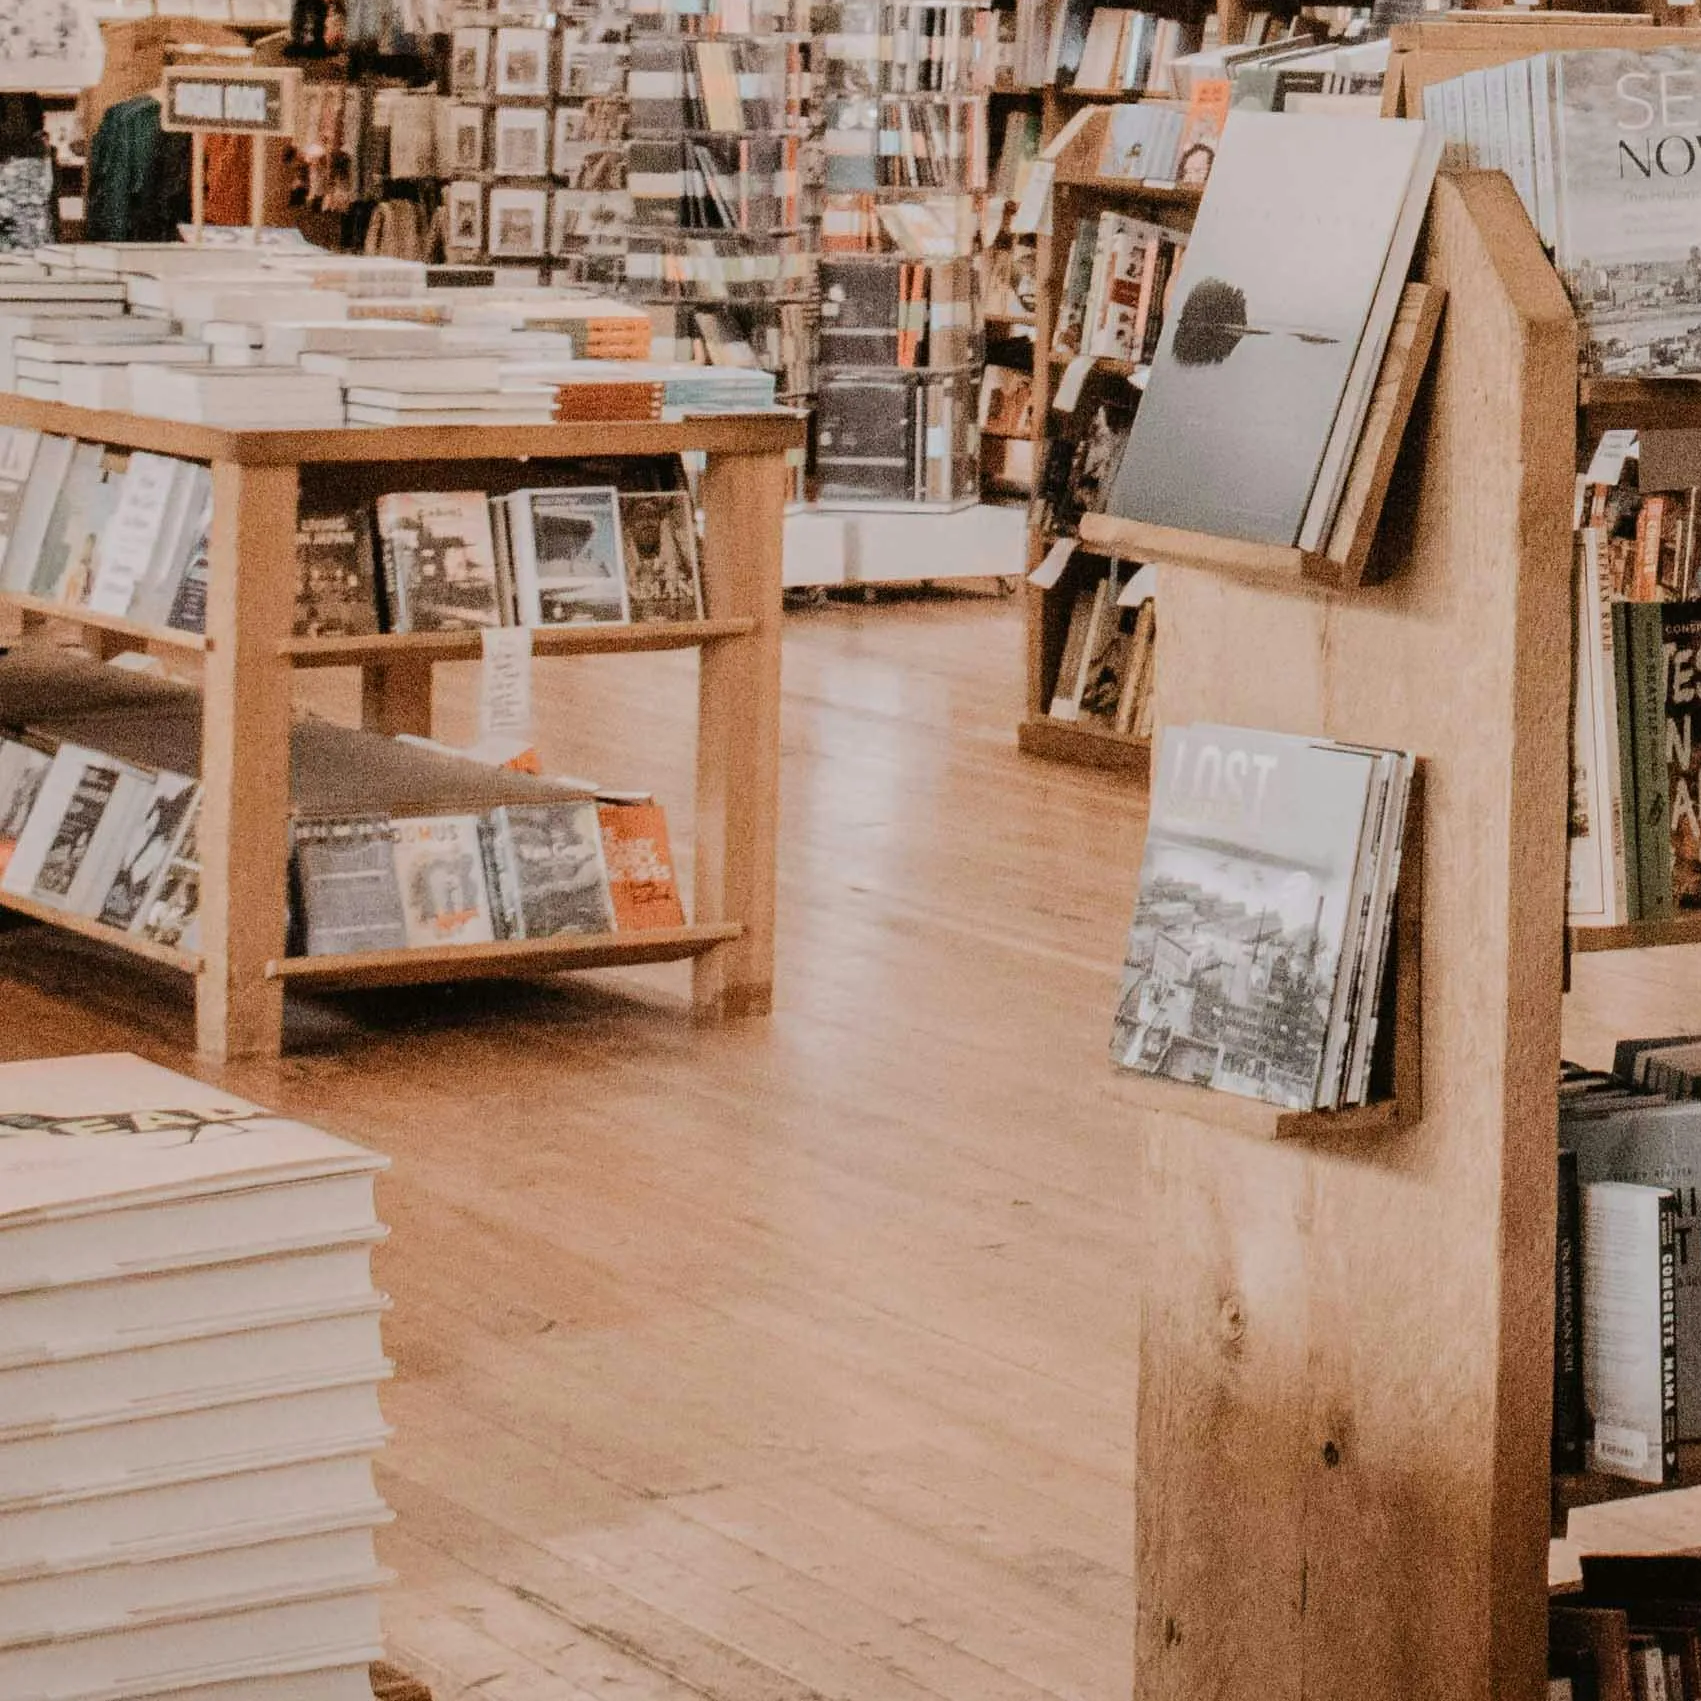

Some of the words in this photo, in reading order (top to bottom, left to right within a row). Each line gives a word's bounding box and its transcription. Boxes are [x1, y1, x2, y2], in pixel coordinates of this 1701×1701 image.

[1599, 542, 1610, 606] ORPHAN
[1601, 612, 1612, 652] ROAD
[1168, 742, 1279, 803] LOST
[1563, 1265, 1573, 1339] AMERICAN
[1662, 1253, 1675, 1349] CONCRETE
[1663, 1356, 1676, 1411] MAMA
